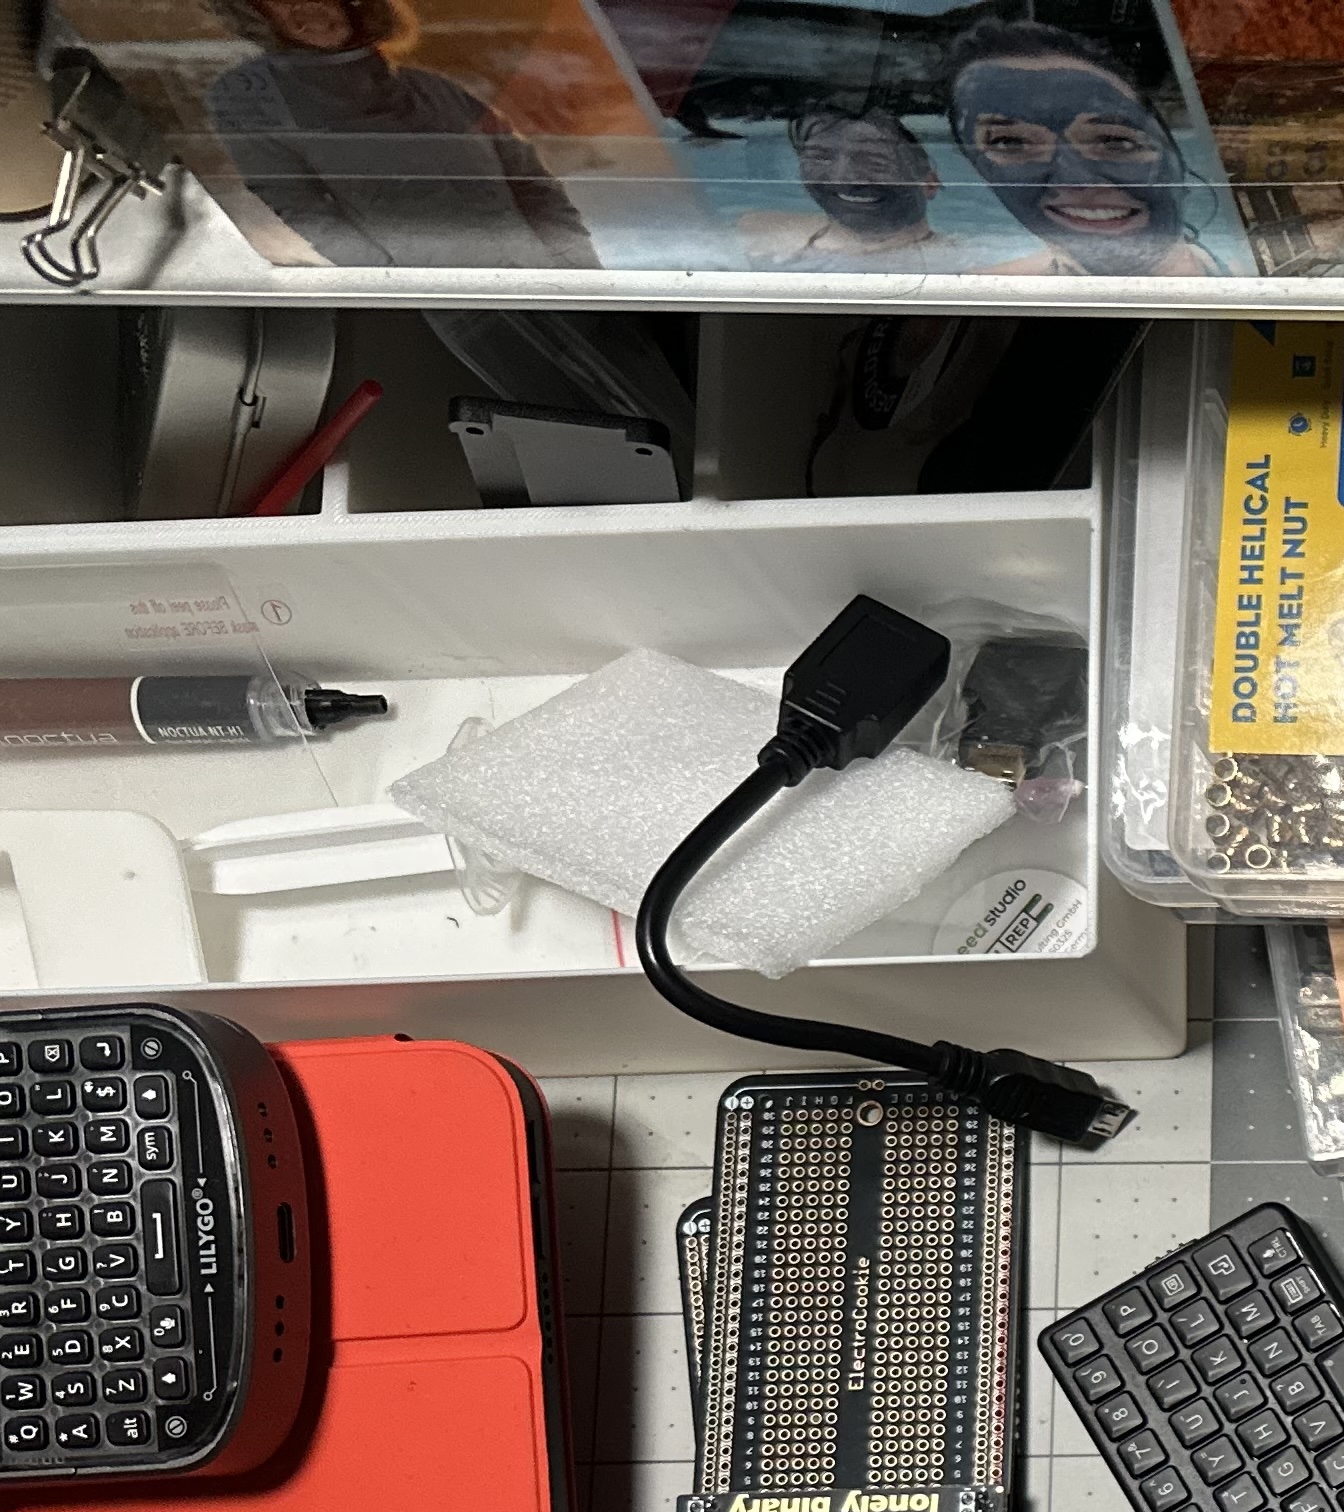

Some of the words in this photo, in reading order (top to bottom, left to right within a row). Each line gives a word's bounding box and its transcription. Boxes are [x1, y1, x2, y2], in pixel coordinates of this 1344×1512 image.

[1239, 454, 1271, 585] HELICAL
[1282, 496, 1309, 558] NUT
[1277, 567, 1305, 646] MELT
[1232, 594, 1262, 723] DOUBLE
[1273, 654, 1300, 724] HOT
[158, 726, 205, 739] NOCTUA
[984, 879, 1027, 927] studio
[1005, 917, 1031, 946] REP
[145, 1132, 158, 1161] sym
[848, 1255, 872, 1391] ElectroCookie
[126, 1417, 140, 1439] alt
